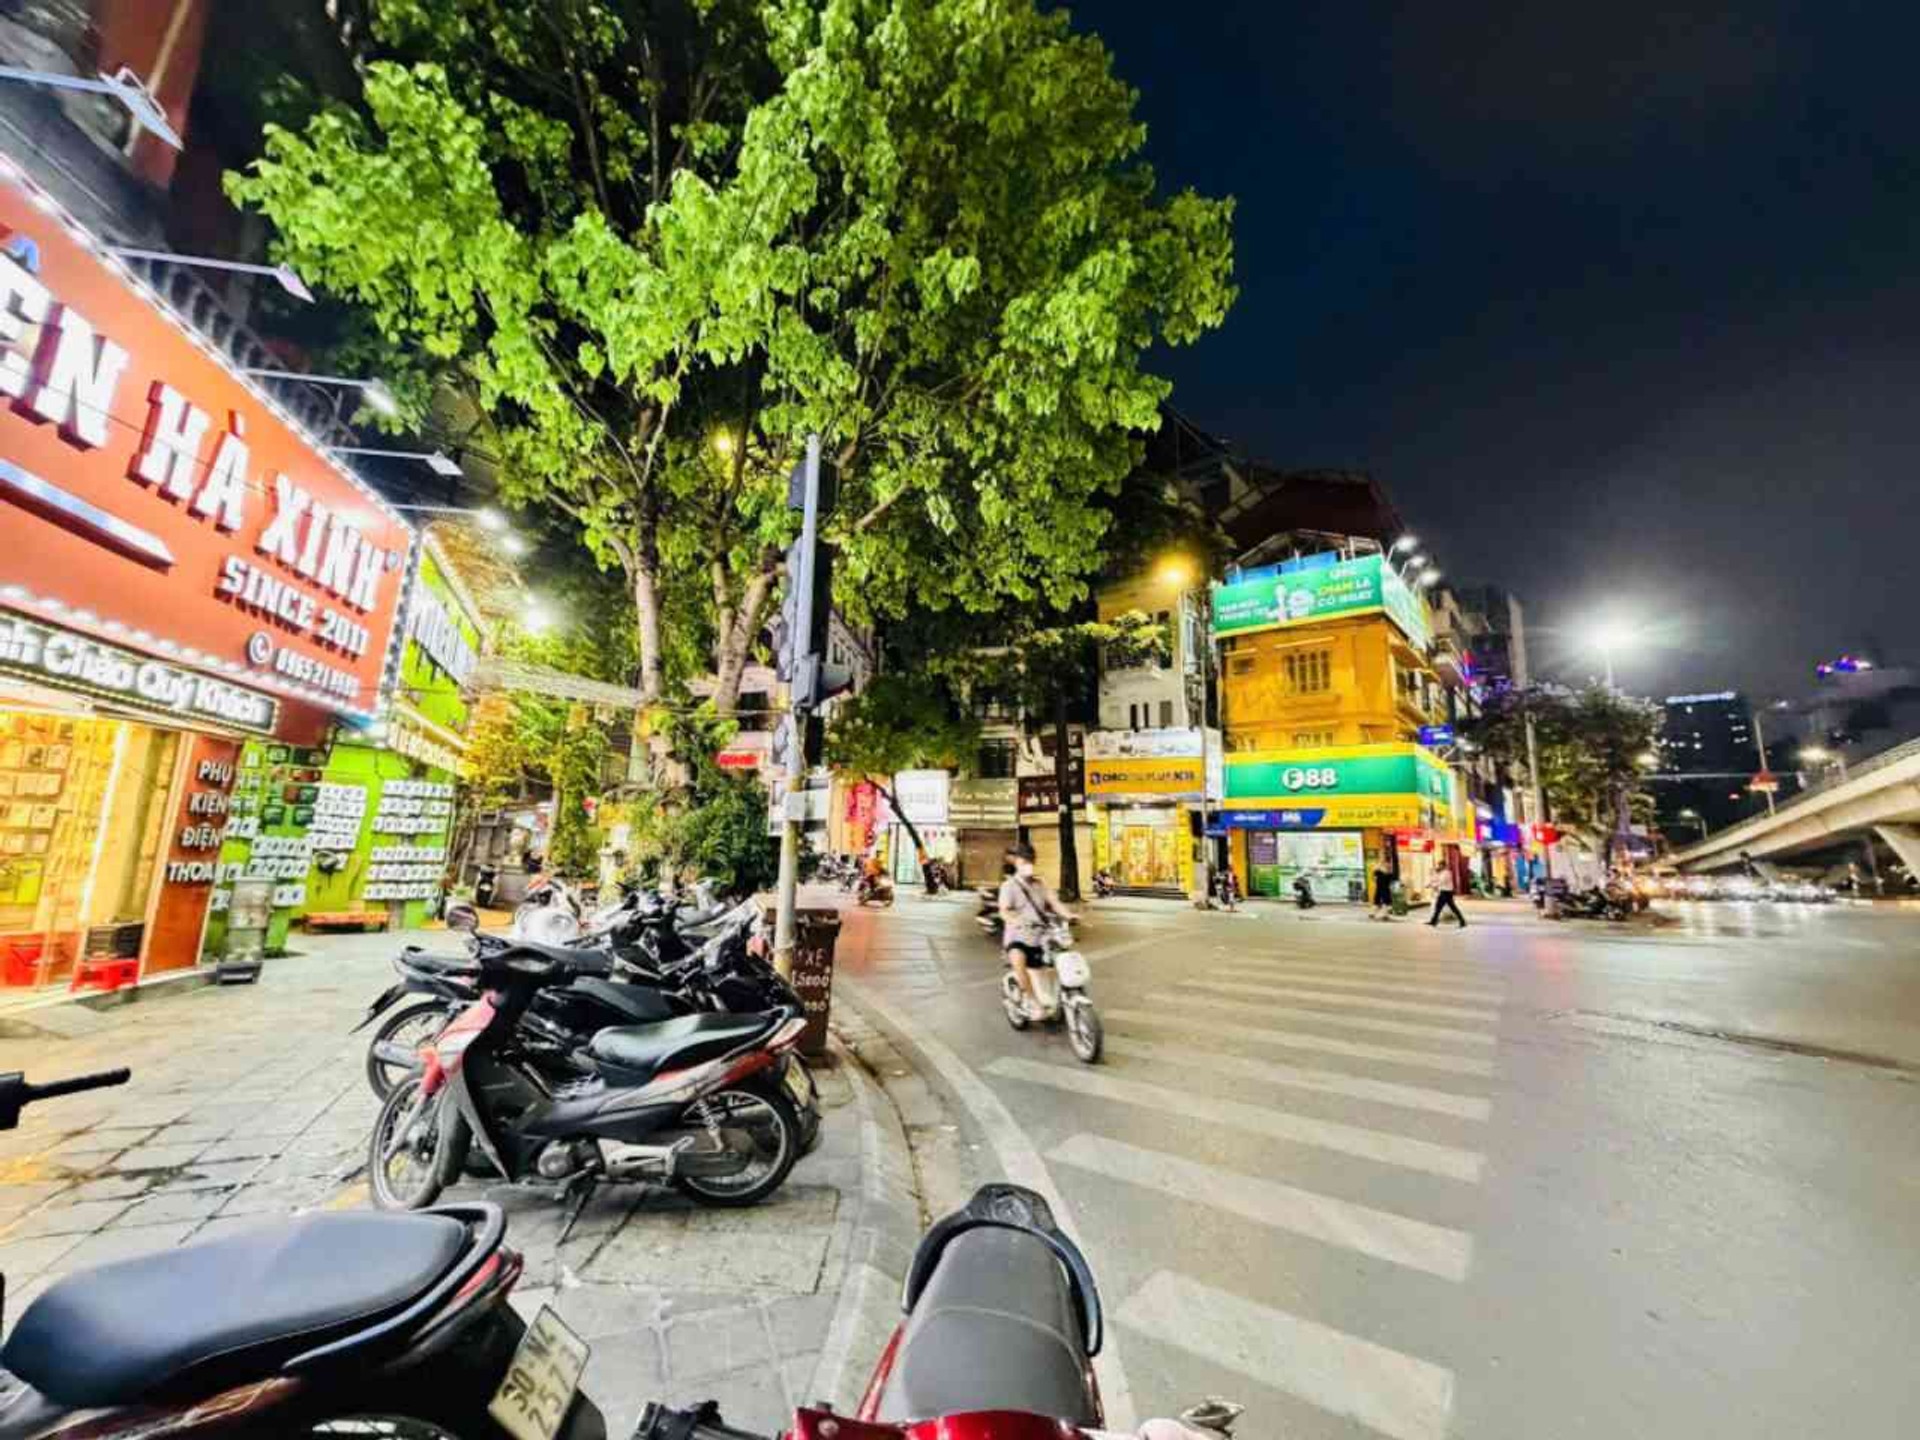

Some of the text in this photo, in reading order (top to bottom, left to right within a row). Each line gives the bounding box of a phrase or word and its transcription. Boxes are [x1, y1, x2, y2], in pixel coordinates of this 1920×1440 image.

[130, 382, 249, 534] HÀ
[216, 554, 316, 634] SINCE
[137, 660, 194, 710] Quý
[190, 789, 228, 817] KIỆN
[1282, 767, 1337, 792] F88
